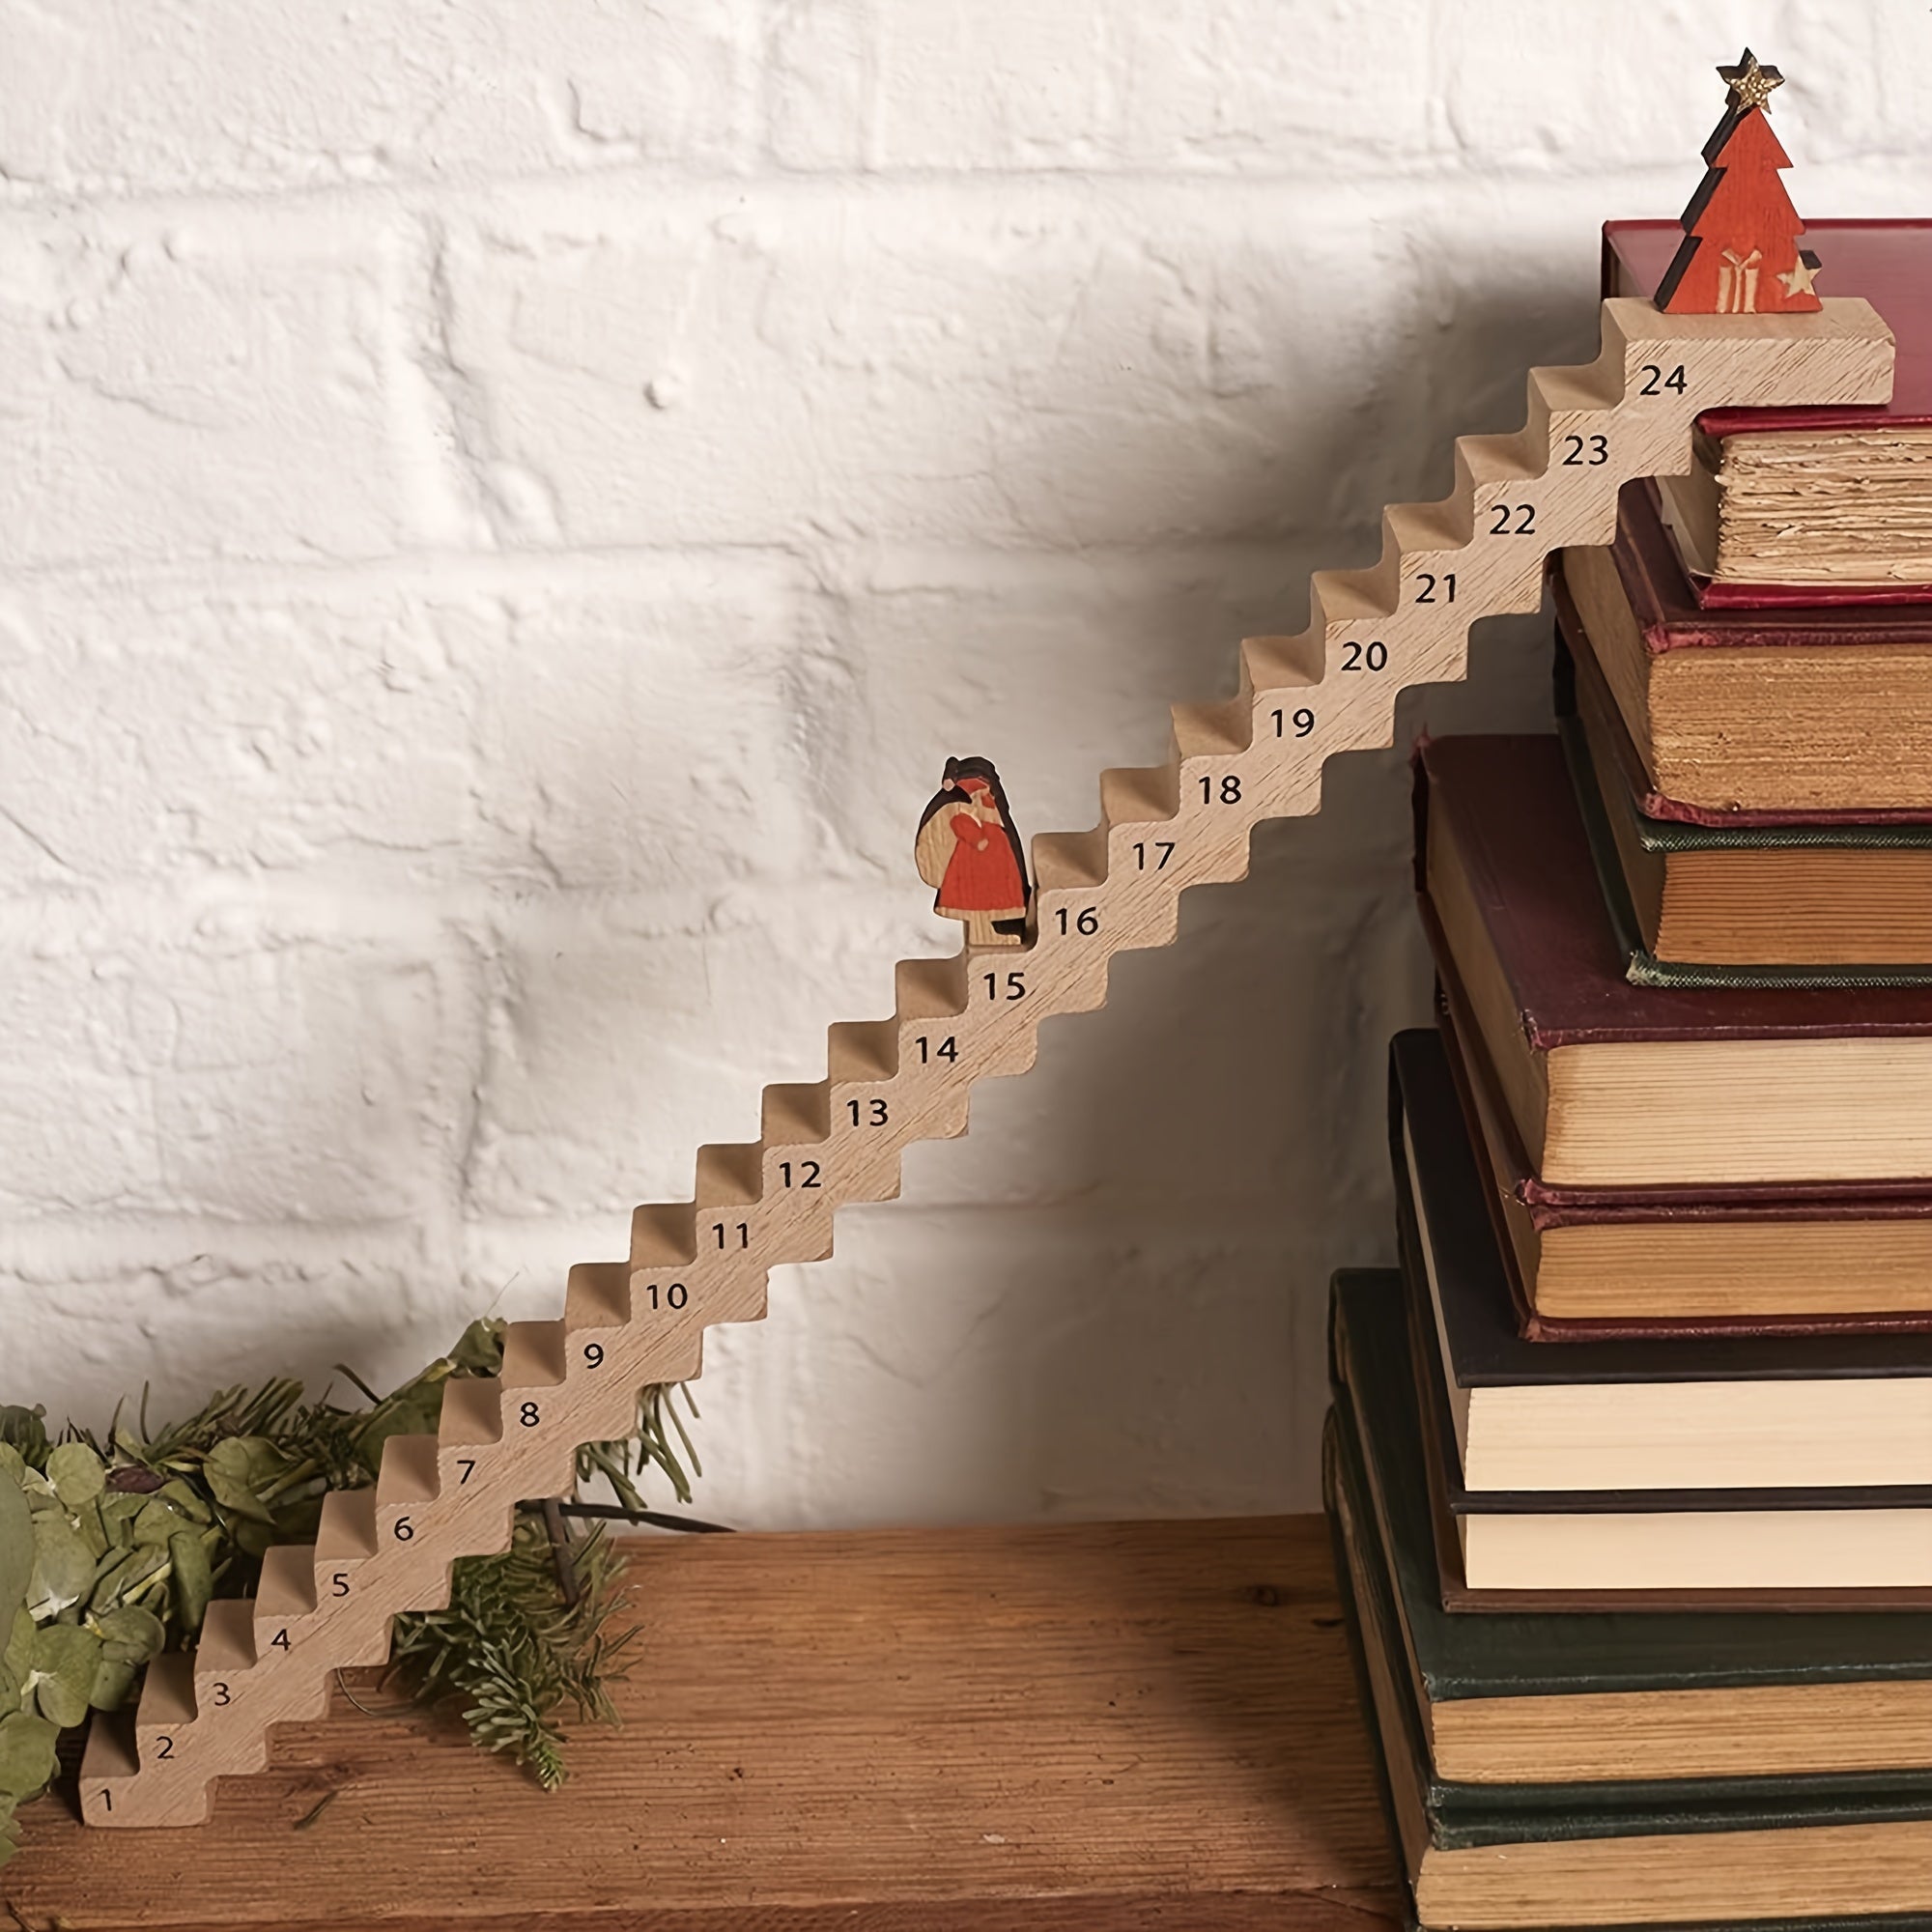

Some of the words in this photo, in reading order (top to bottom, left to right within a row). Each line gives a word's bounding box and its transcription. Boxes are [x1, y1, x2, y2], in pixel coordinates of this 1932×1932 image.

[1639, 364, 1688, 396] 24
[1562, 435, 1609, 466] 23
[1489, 503, 1536, 535] 22
[1414, 573, 1456, 604] 21
[1341, 640, 1388, 672] 20
[1270, 708, 1315, 738] 19
[1198, 775, 1242, 805] 18
[1132, 841, 1176, 870] 17
[1055, 906, 1099, 936] 16
[982, 972, 1026, 1001] 15
[915, 1036, 959, 1065] 14
[846, 1098, 889, 1127] 13
[779, 1160, 822, 1189] 12
[712, 1222, 749, 1250] 11
[646, 1283, 689, 1310] 10
[583, 1343, 605, 1370] 9
[519, 1401, 540, 1428] 8
[456, 1459, 476, 1486] 7
[393, 1516, 414, 1542] 6
[332, 1573, 351, 1598] 5
[270, 1628, 292, 1652] 4
[213, 1682, 231, 1707] 3
[156, 1735, 176, 1760] 2
[97, 1788, 112, 1812] 1
